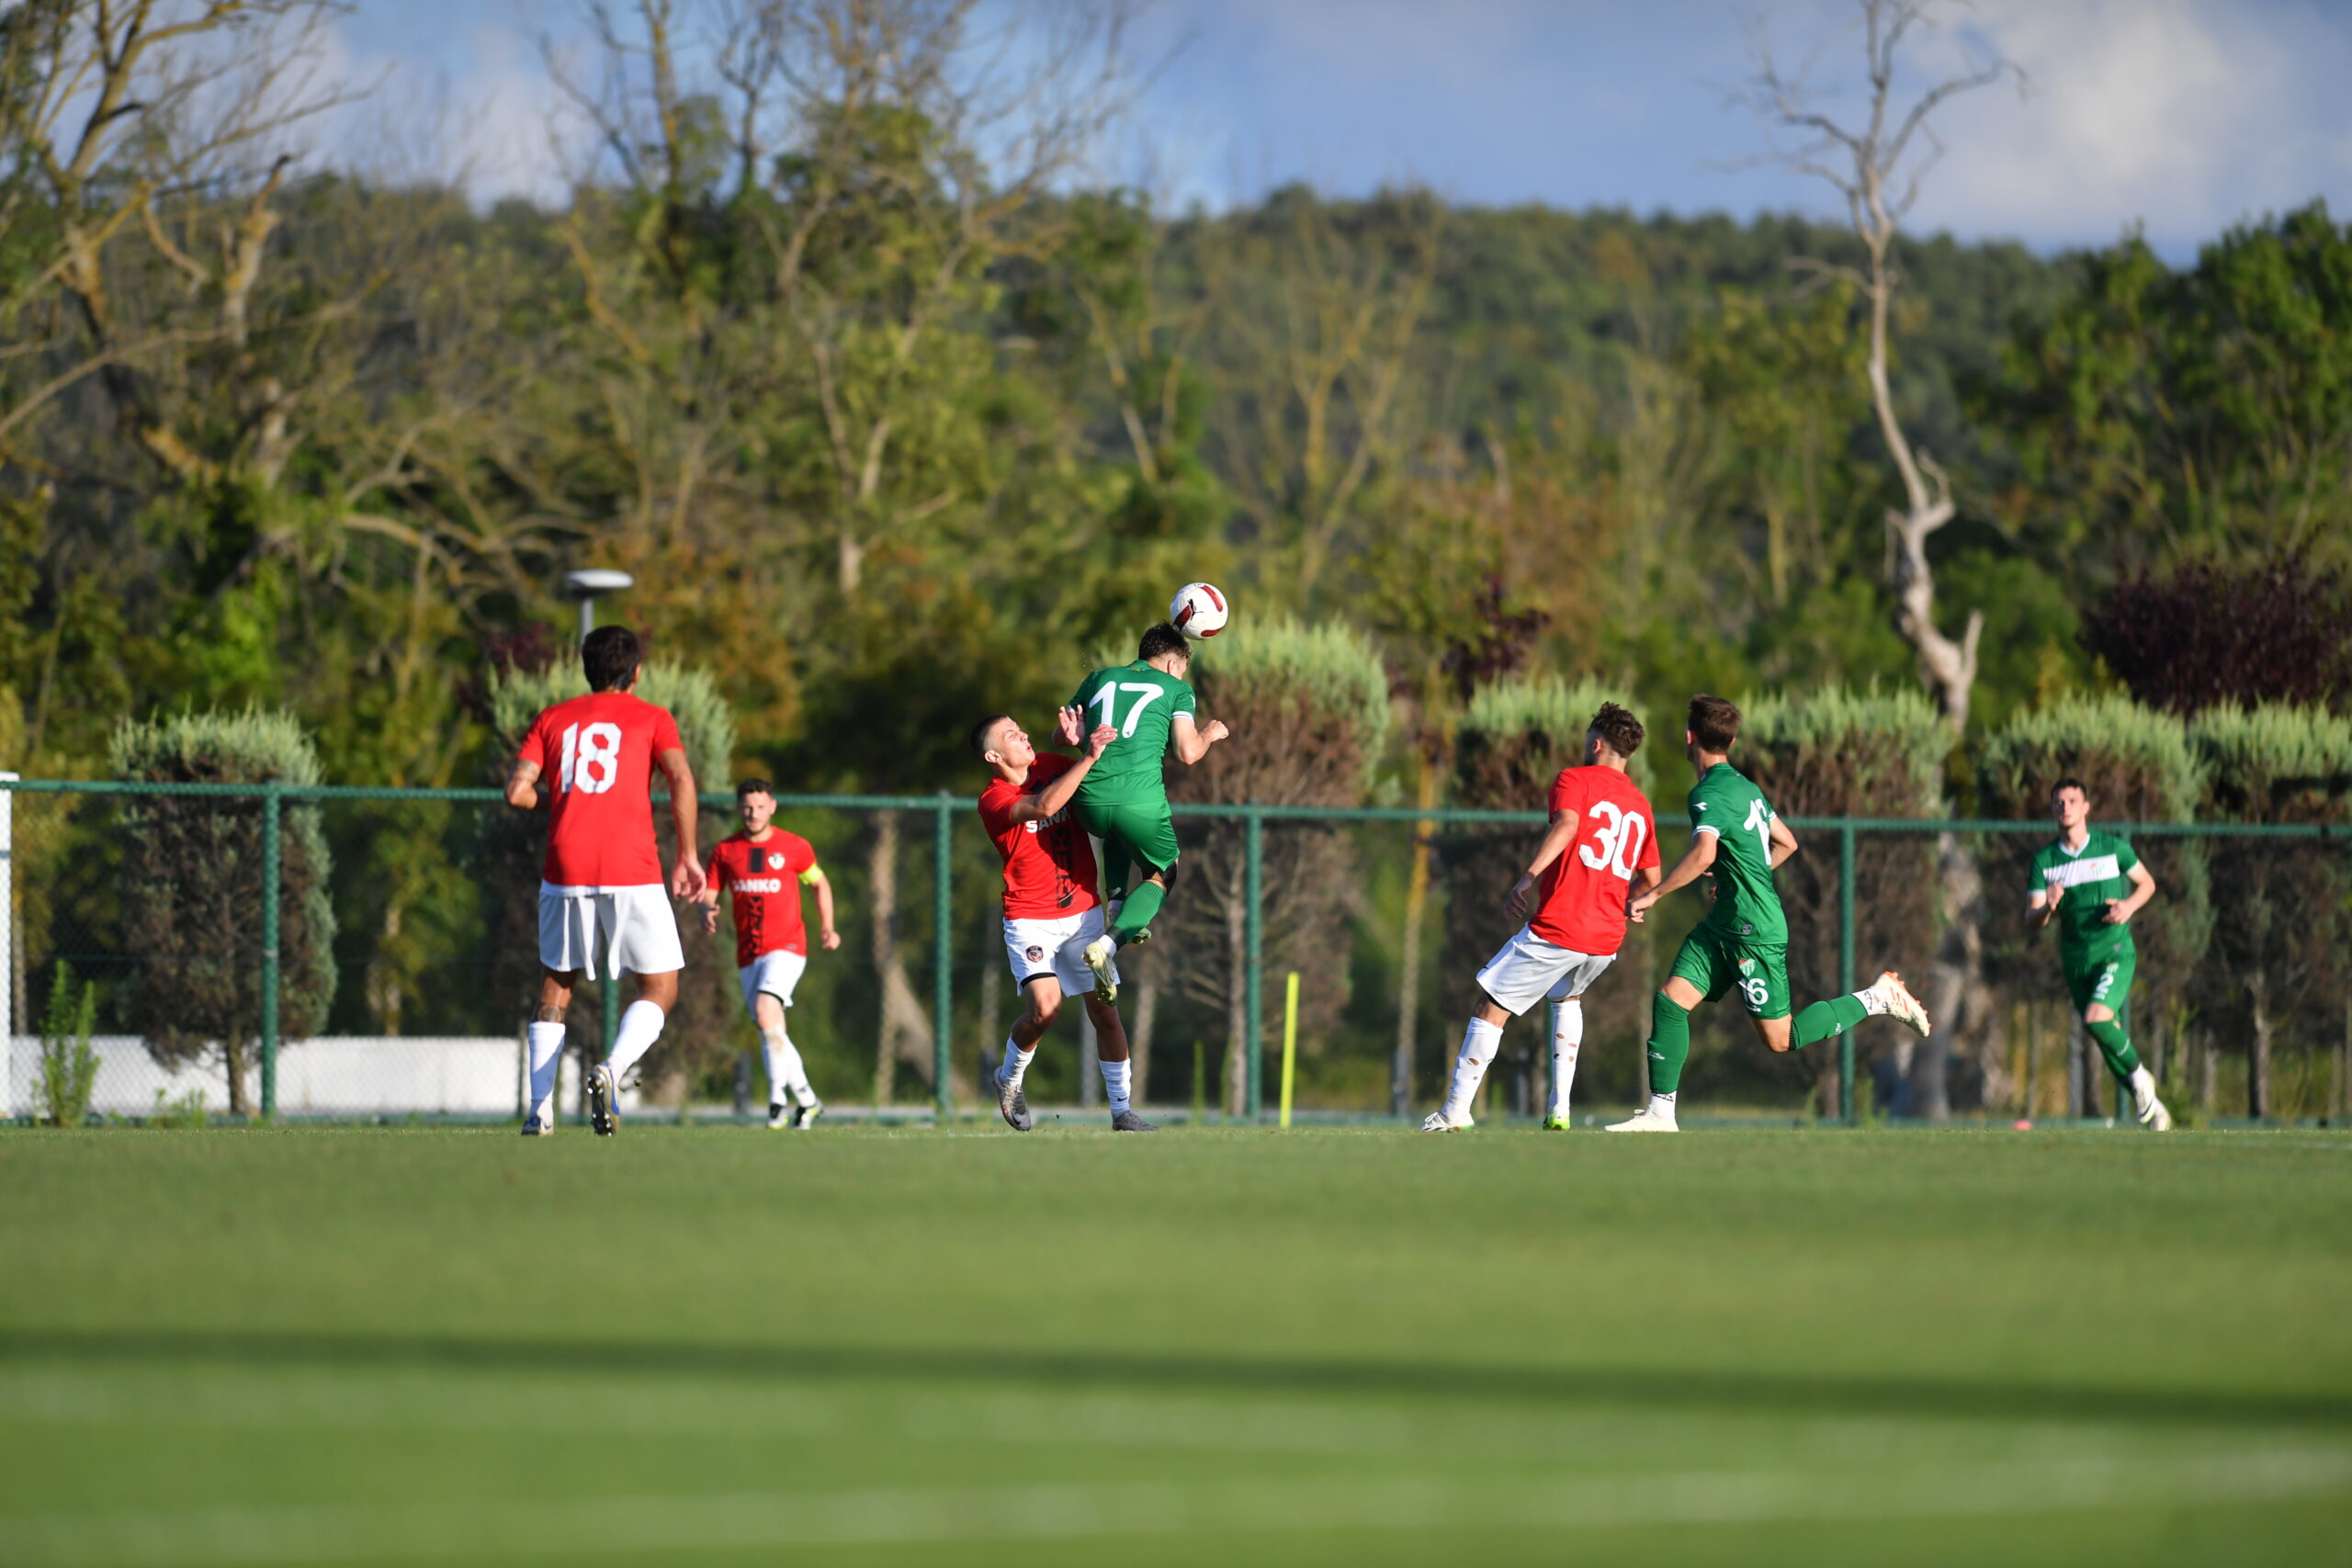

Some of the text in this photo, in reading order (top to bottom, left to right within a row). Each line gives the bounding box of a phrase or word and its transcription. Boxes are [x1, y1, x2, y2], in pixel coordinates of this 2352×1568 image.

[1089, 681, 1164, 739] 17
[560, 721, 622, 794] 18
[1025, 805, 1073, 833] SANK
[1578, 800, 1646, 881] 30
[1737, 977, 1769, 1005] 16
